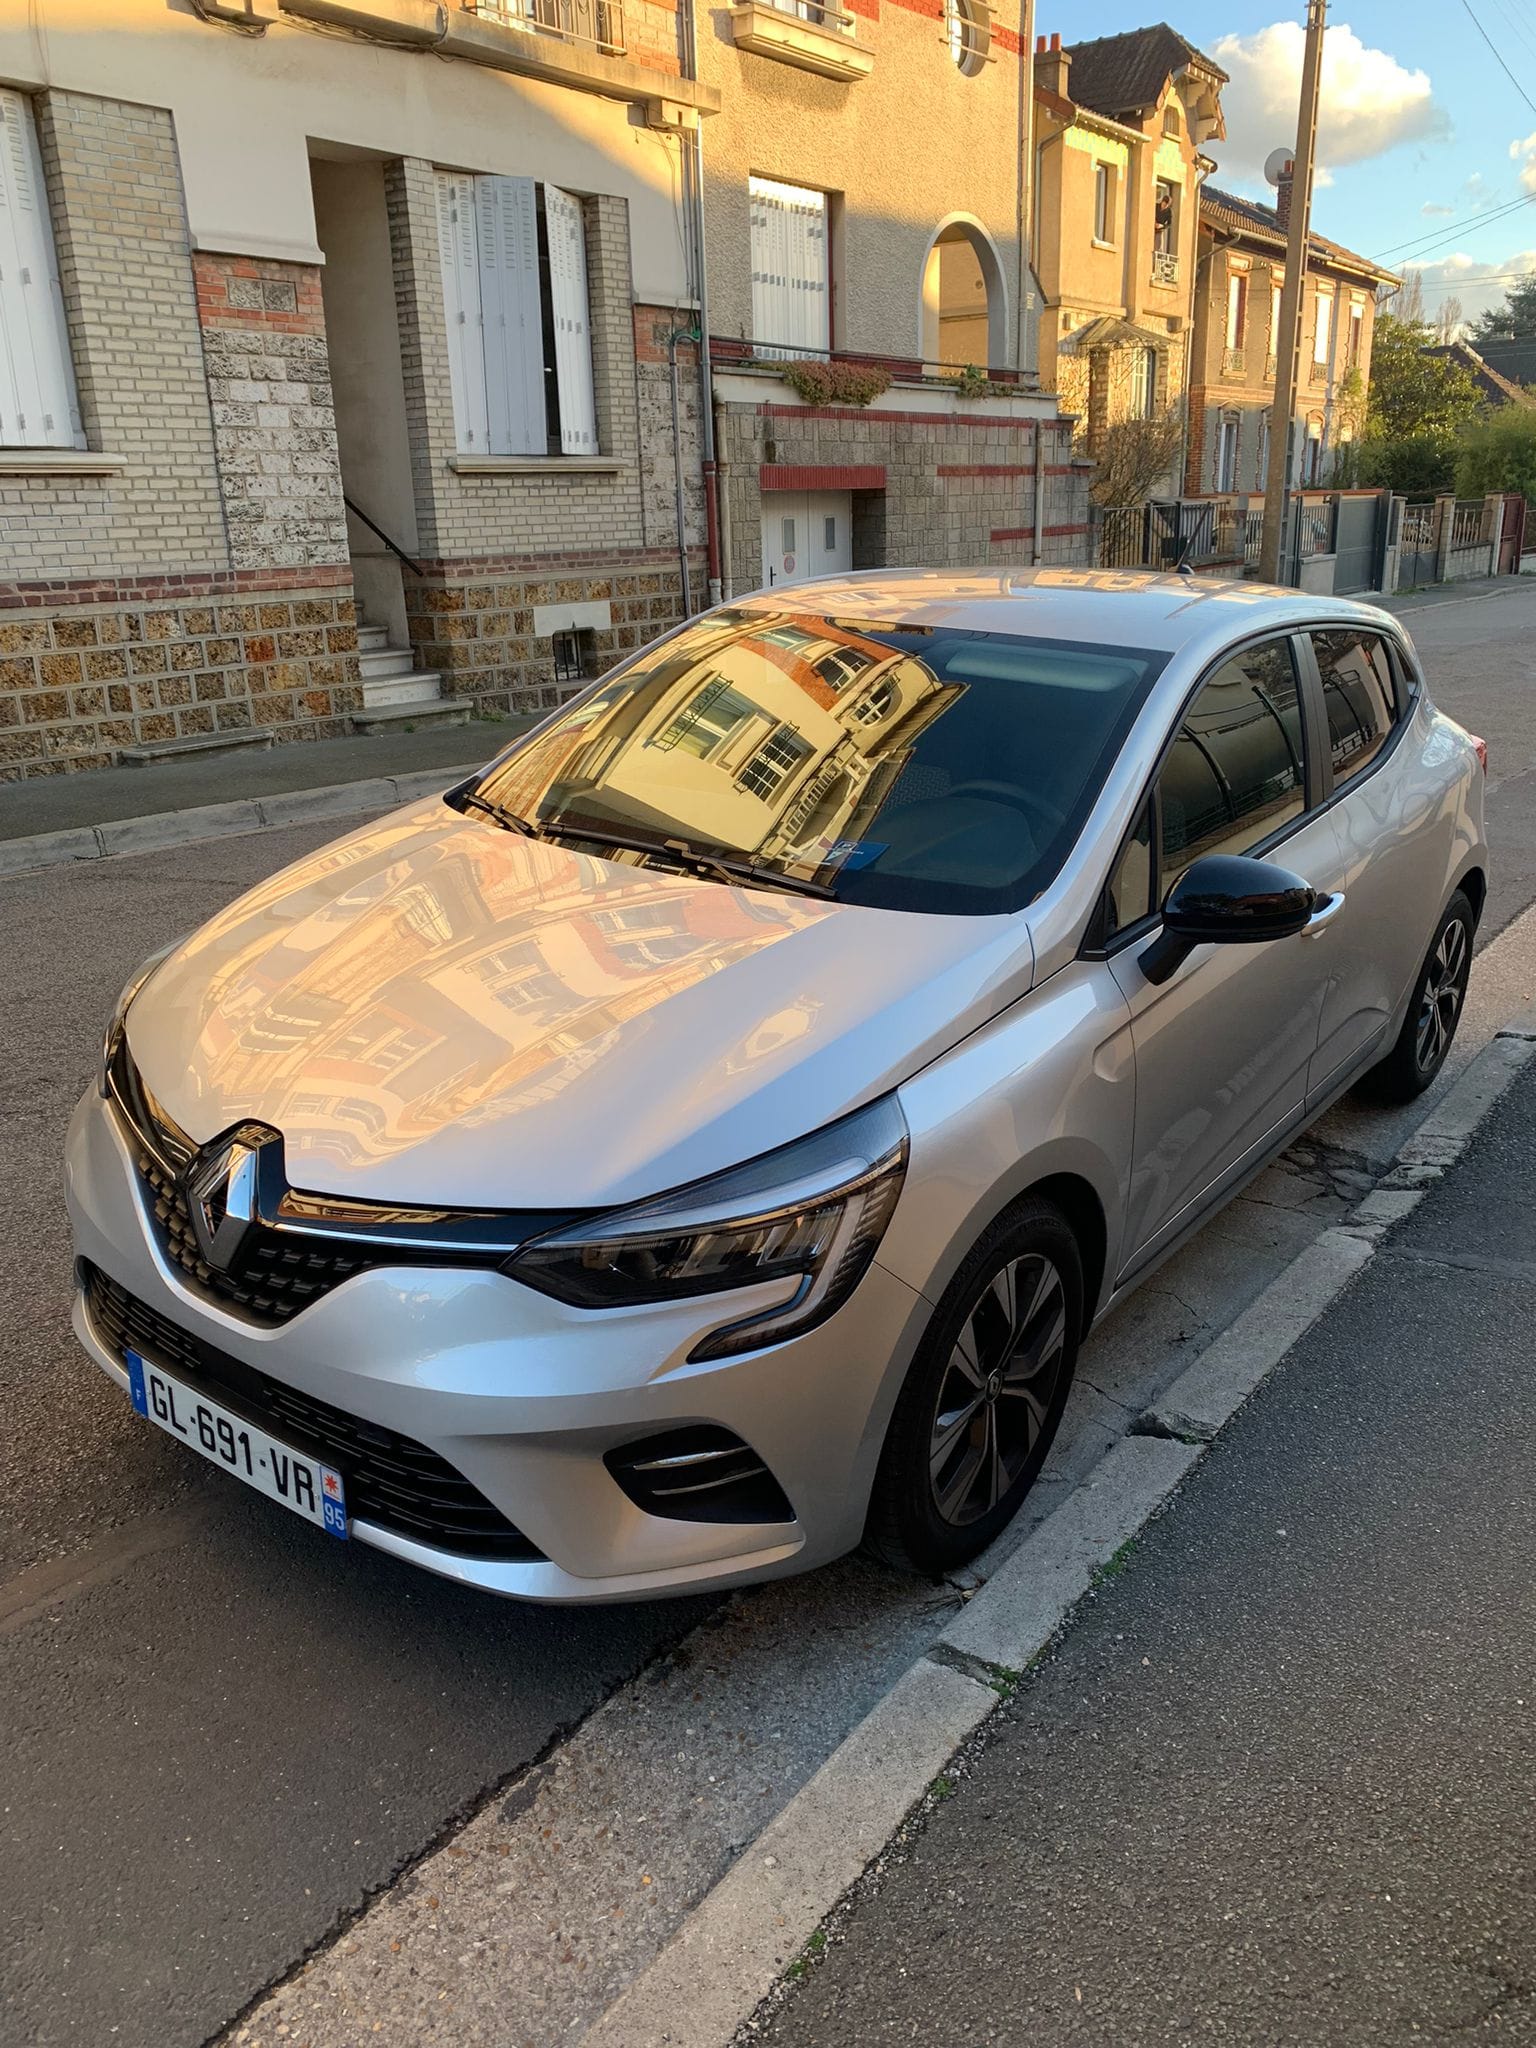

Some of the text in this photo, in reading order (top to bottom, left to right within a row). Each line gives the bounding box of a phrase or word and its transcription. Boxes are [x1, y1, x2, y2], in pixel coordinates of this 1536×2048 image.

[135, 1388, 142, 1401] F
[150, 1375, 315, 1513] GL-691-VR
[325, 1503, 345, 1531] 95
